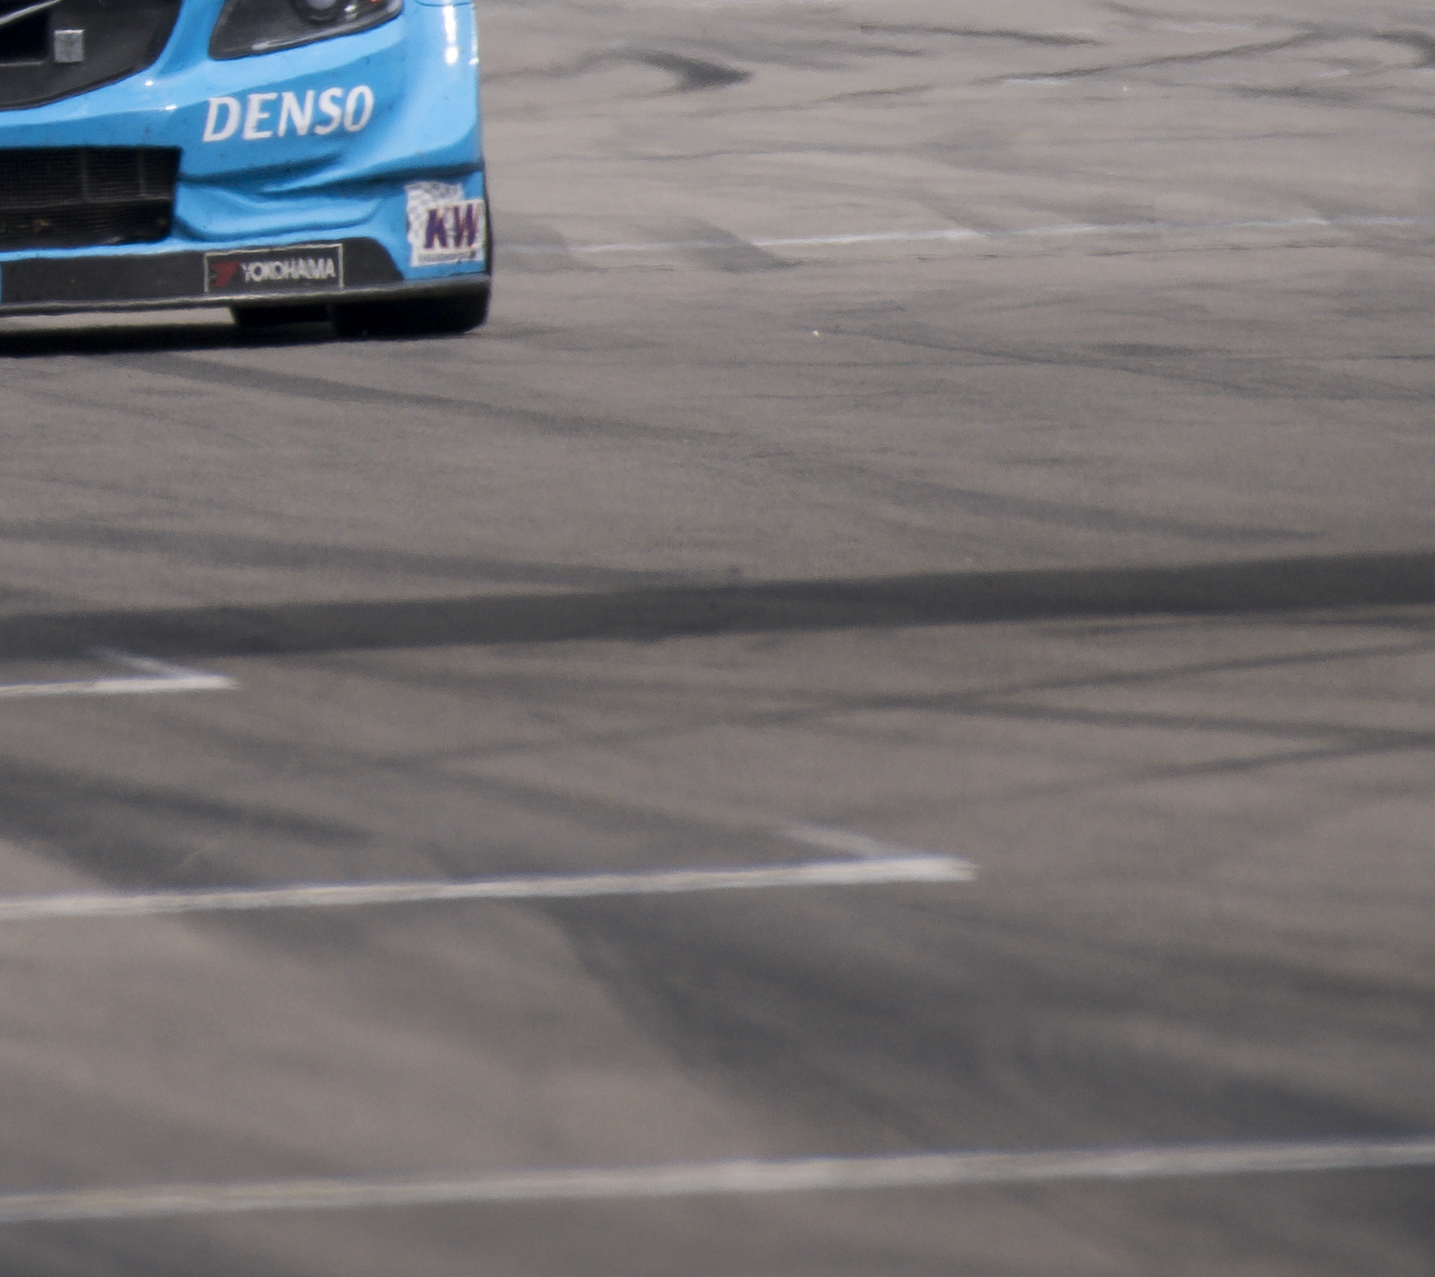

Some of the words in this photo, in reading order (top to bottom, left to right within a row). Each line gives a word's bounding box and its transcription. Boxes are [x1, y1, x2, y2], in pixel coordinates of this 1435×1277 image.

[203, 85, 374, 142] DENSO
[424, 203, 480, 249] KW
[242, 258, 336, 282] YOKOHAMA
